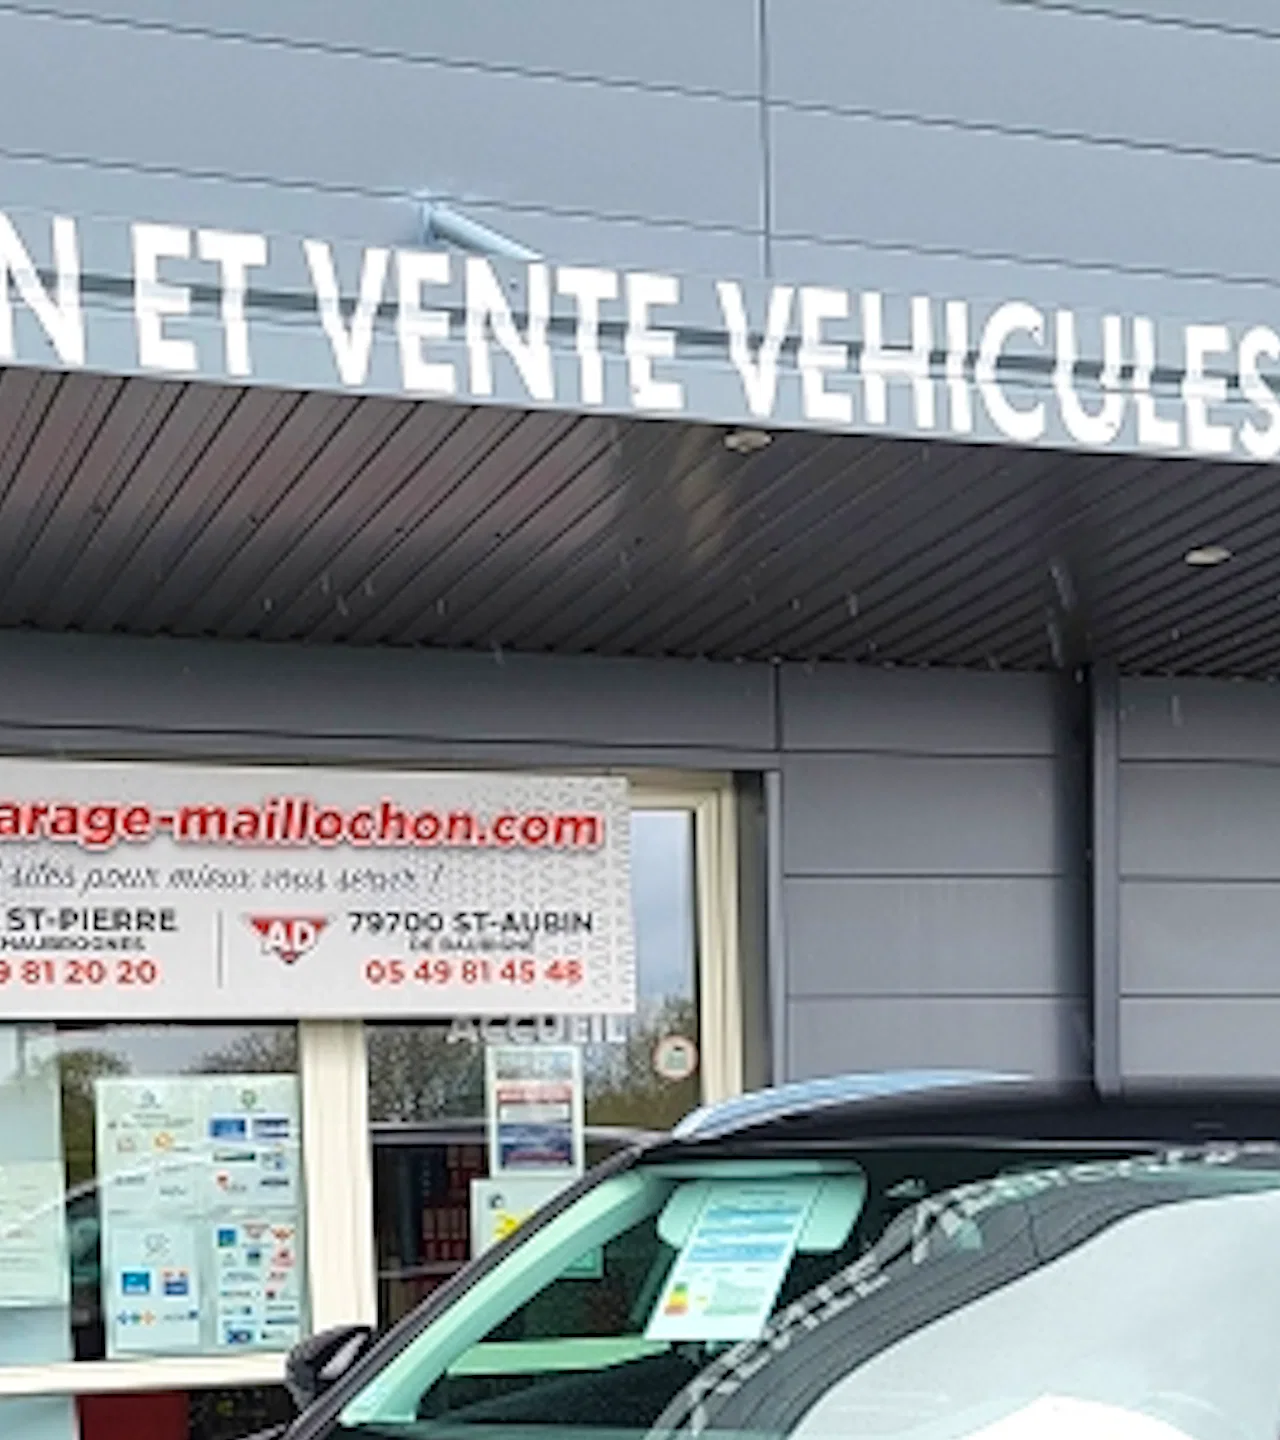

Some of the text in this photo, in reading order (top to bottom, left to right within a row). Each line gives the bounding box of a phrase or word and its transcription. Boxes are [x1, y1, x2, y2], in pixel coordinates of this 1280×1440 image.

[130, 222, 268, 377] ET
[303, 239, 685, 413] VENTE
[7, 907, 179, 931] ST-PIERRE
[347, 911, 593, 934] 79700 ST-AUBIN
[260, 919, 317, 953] AD
[21, 959, 56, 984] 81
[65, 959, 107, 984] 20
[116, 959, 158, 984] 20
[365, 959, 405, 984] 05
[413, 959, 452, 984] 49
[460, 959, 490, 984] 81
[499, 959, 536, 984] 45
[445, 1014, 628, 1045] ACCUEIL
